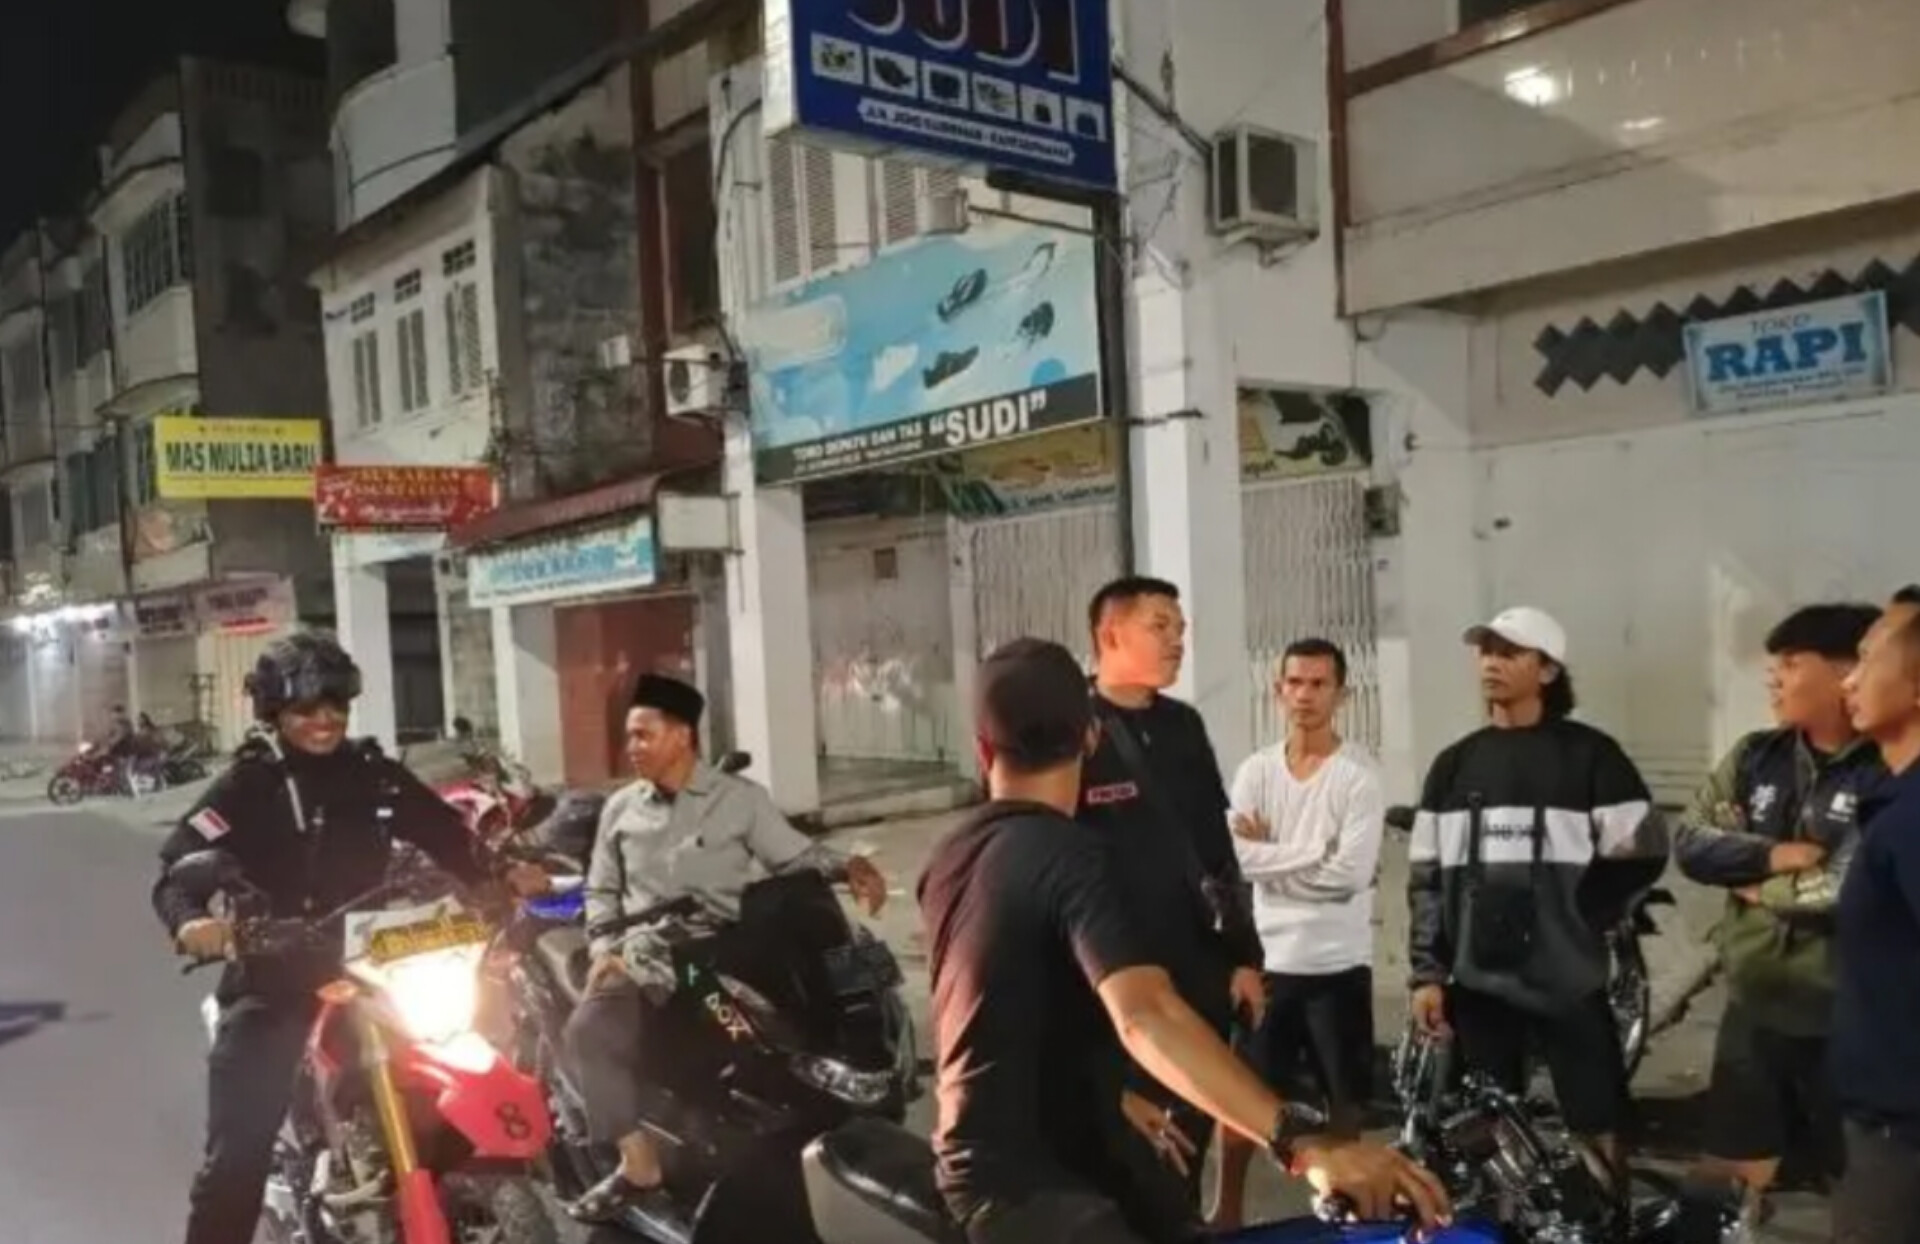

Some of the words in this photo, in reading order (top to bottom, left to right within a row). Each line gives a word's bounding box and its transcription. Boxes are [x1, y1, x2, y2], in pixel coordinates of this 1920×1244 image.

[1705, 321, 1867, 382] RAPI
[165, 442, 204, 473] MAS
[494, 1102, 533, 1140] 8
